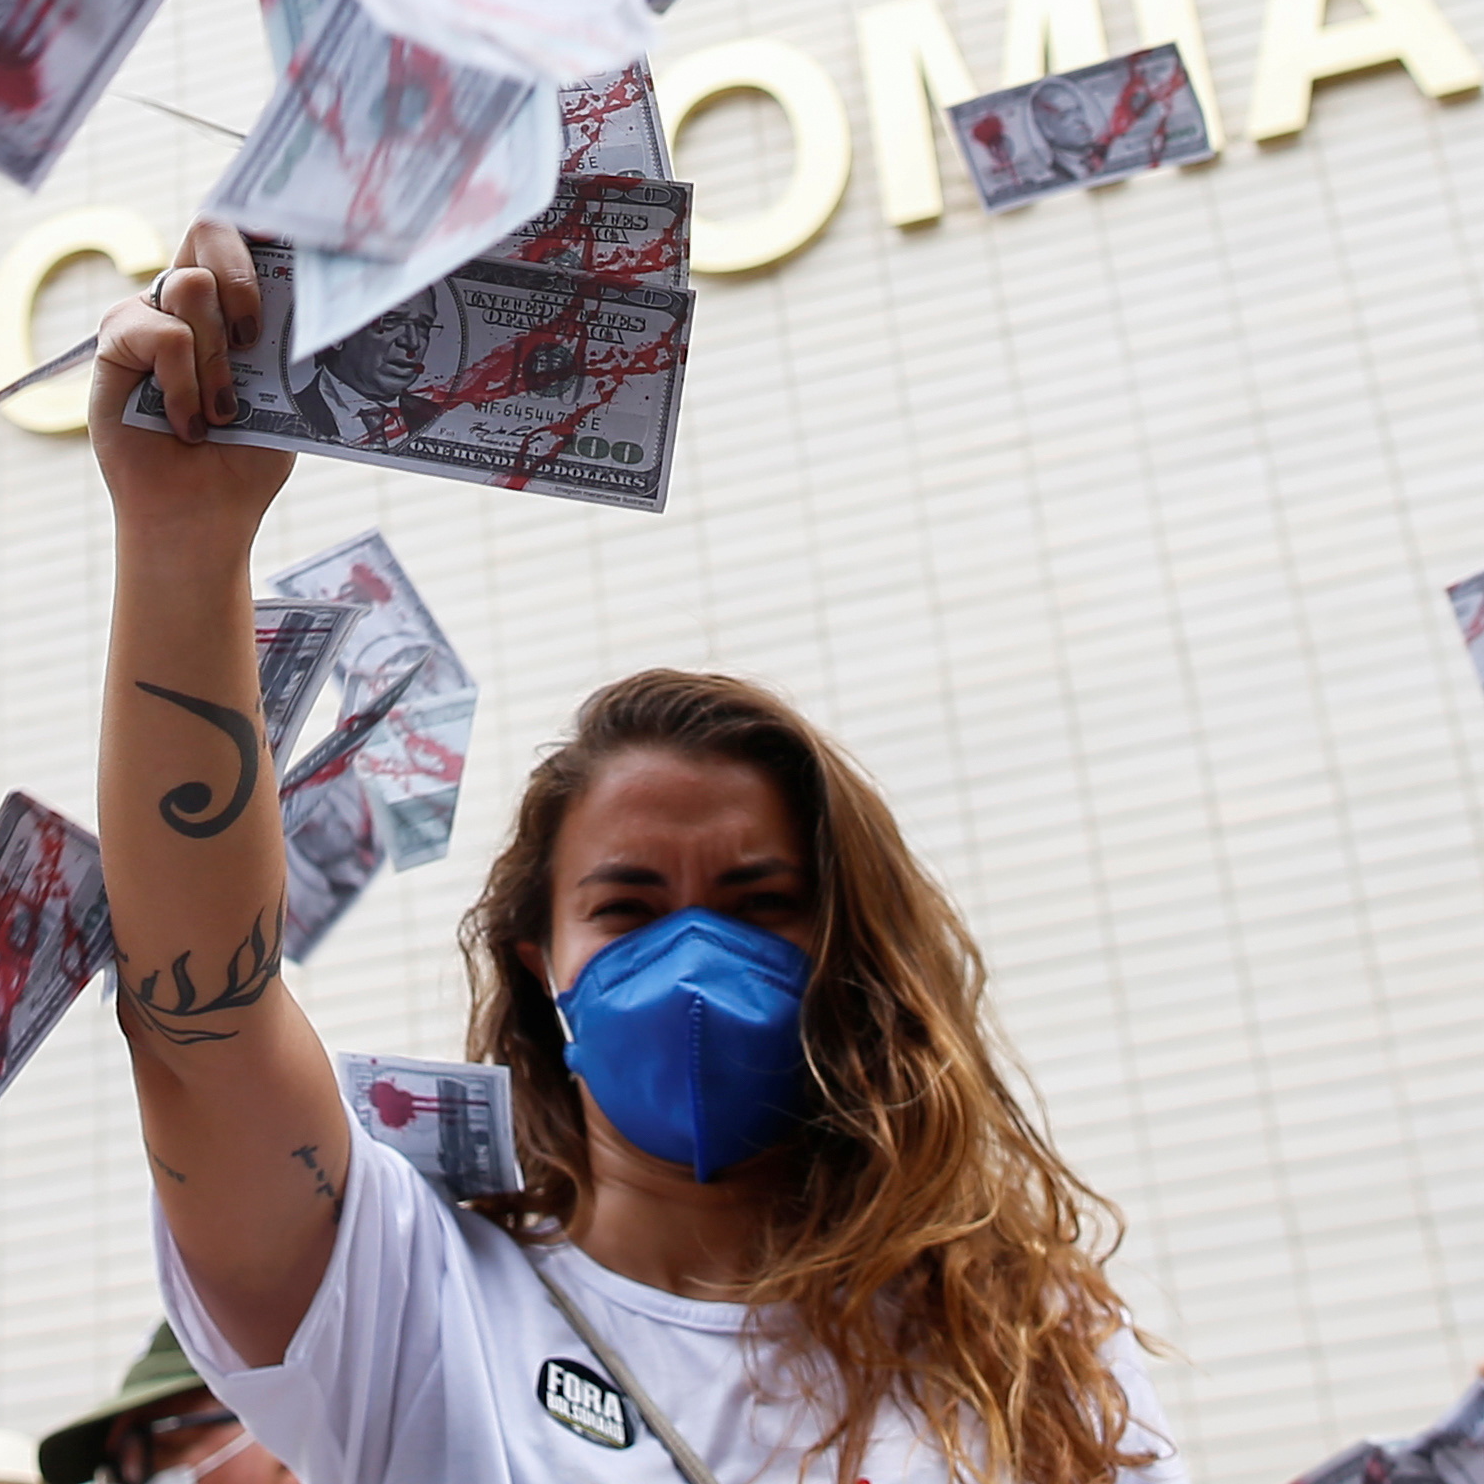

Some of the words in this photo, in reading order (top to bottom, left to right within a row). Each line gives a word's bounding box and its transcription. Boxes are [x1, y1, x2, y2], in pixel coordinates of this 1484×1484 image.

[409, 439, 451, 458] ONE
[552, 464, 646, 488] DOLLARS
[546, 1361, 624, 1424] FORA
